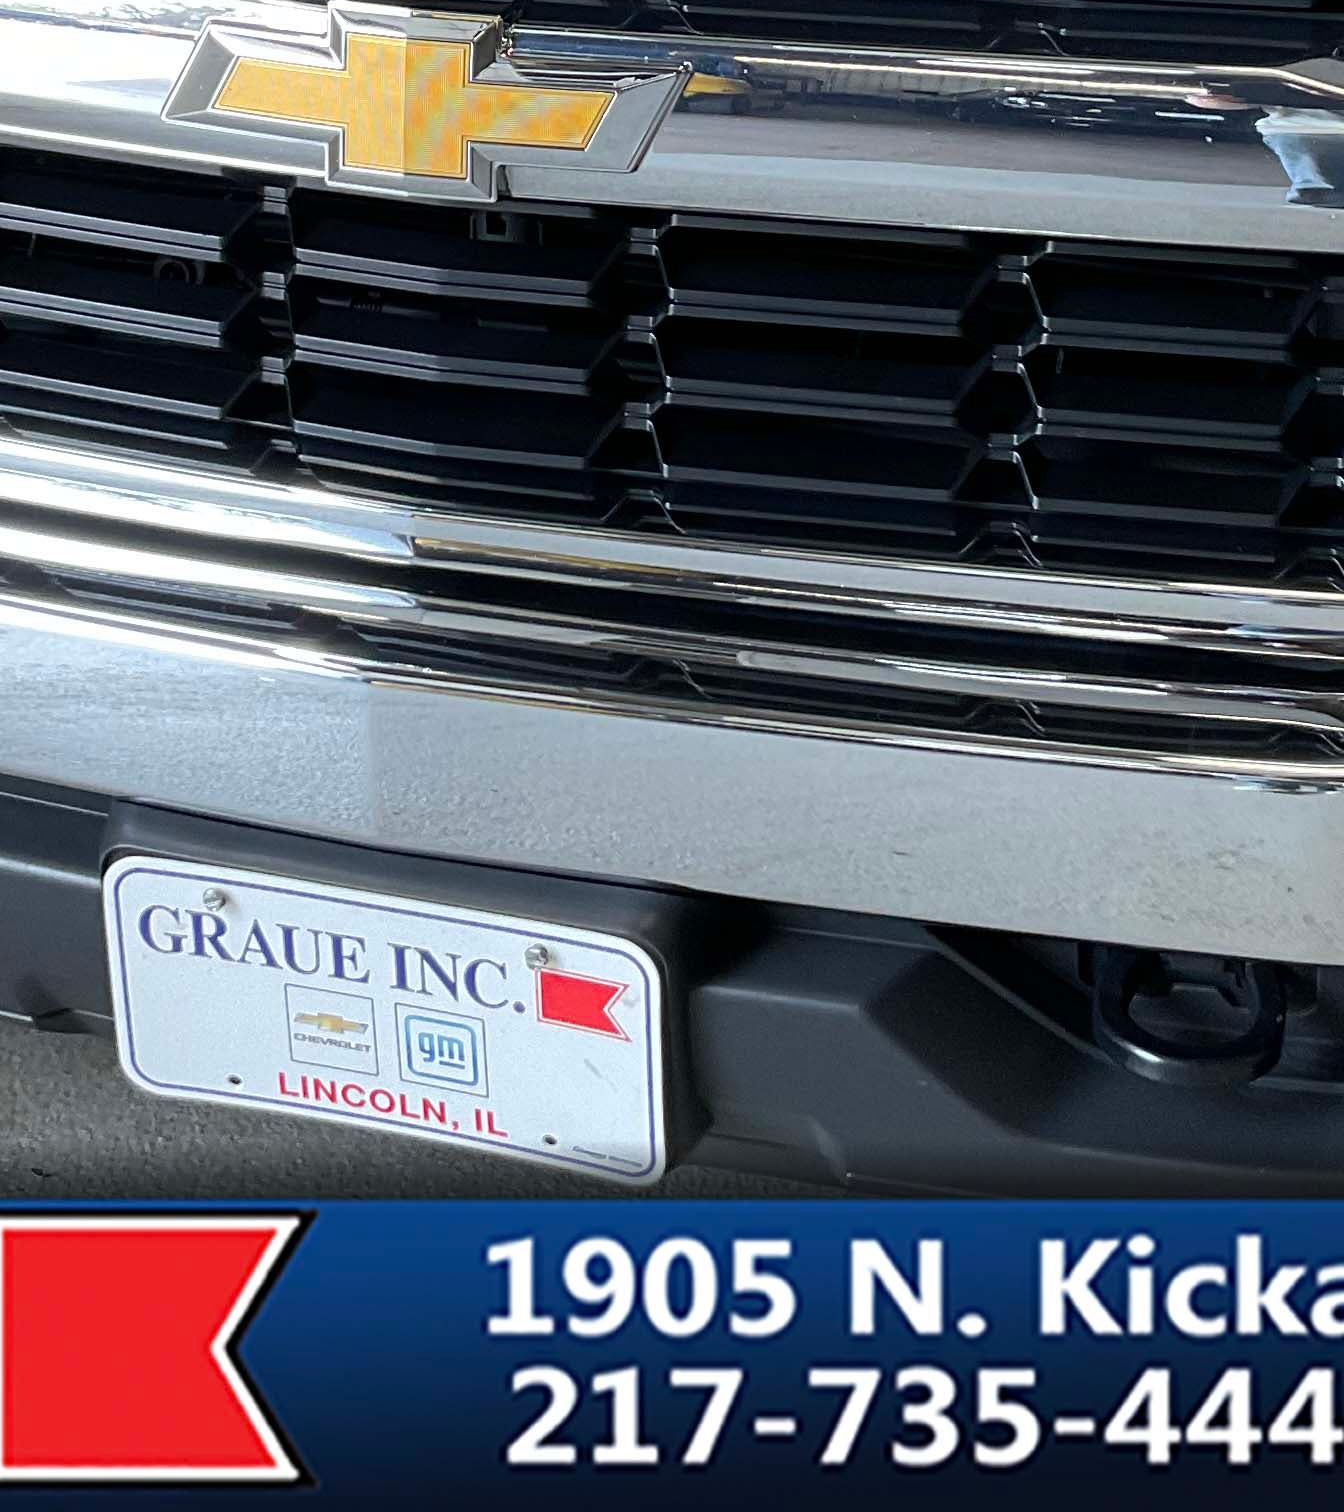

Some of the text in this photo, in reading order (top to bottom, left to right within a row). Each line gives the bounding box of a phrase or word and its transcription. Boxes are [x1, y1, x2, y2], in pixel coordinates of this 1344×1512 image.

[138, 903, 528, 1015] GRAUE INC.
[293, 1032, 372, 1054] CHEVROLET
[417, 1031, 467, 1070] gm
[277, 1071, 510, 1139] LINCOLN, IL
